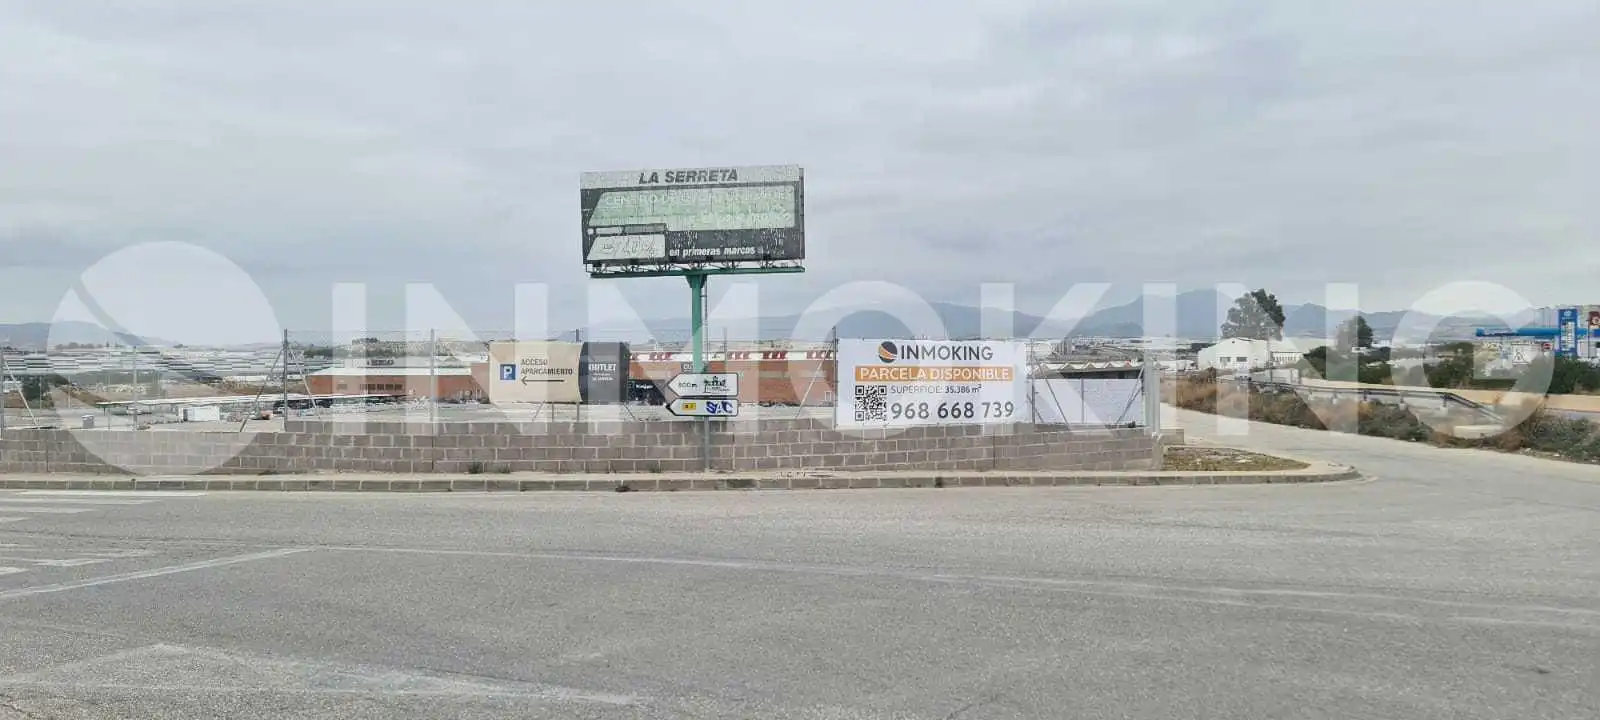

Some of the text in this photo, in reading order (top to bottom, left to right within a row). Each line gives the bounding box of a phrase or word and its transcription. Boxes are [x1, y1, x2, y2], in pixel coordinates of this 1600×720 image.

[639, 169, 738, 184] LA SERRETA
[669, 246, 756, 258] en primeras marcas
[901, 345, 993, 360] INMOKING
[520, 358, 548, 366] ACCESO
[588, 363, 617, 371] OUTLET
[520, 367, 573, 375] APARCAMIENTO
[860, 367, 1009, 380] PARCELA DISPONIBLE
[891, 401, 1014, 419] 968 668 739
